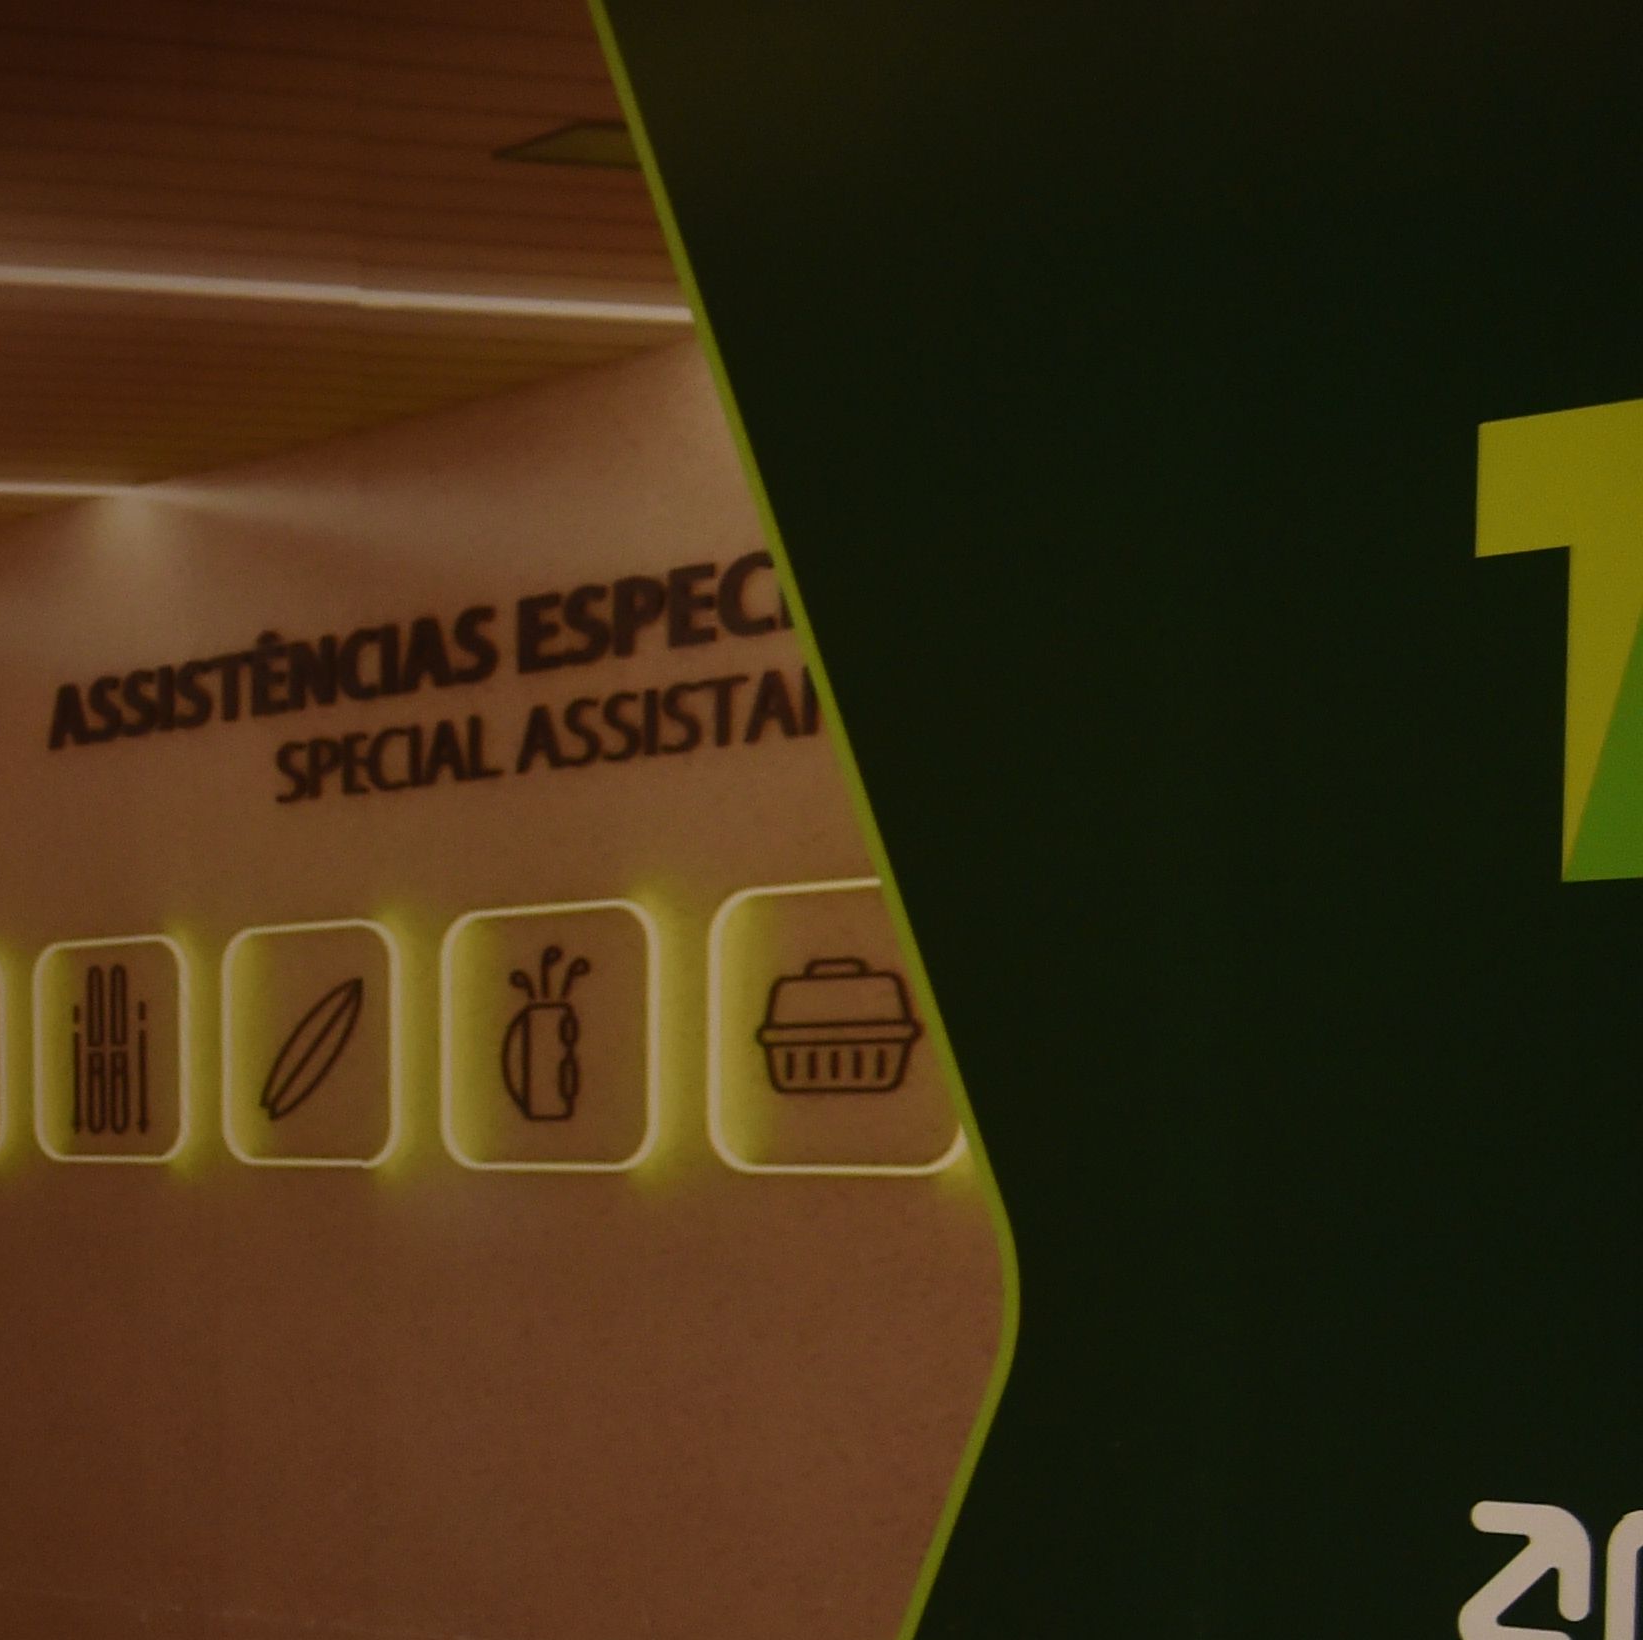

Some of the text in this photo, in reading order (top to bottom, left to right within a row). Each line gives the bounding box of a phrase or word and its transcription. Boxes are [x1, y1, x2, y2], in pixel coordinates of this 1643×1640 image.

[47, 551, 794, 750] ASSISTÊNCIAS ESPEC
[275, 716, 503, 803] SPECIAL
